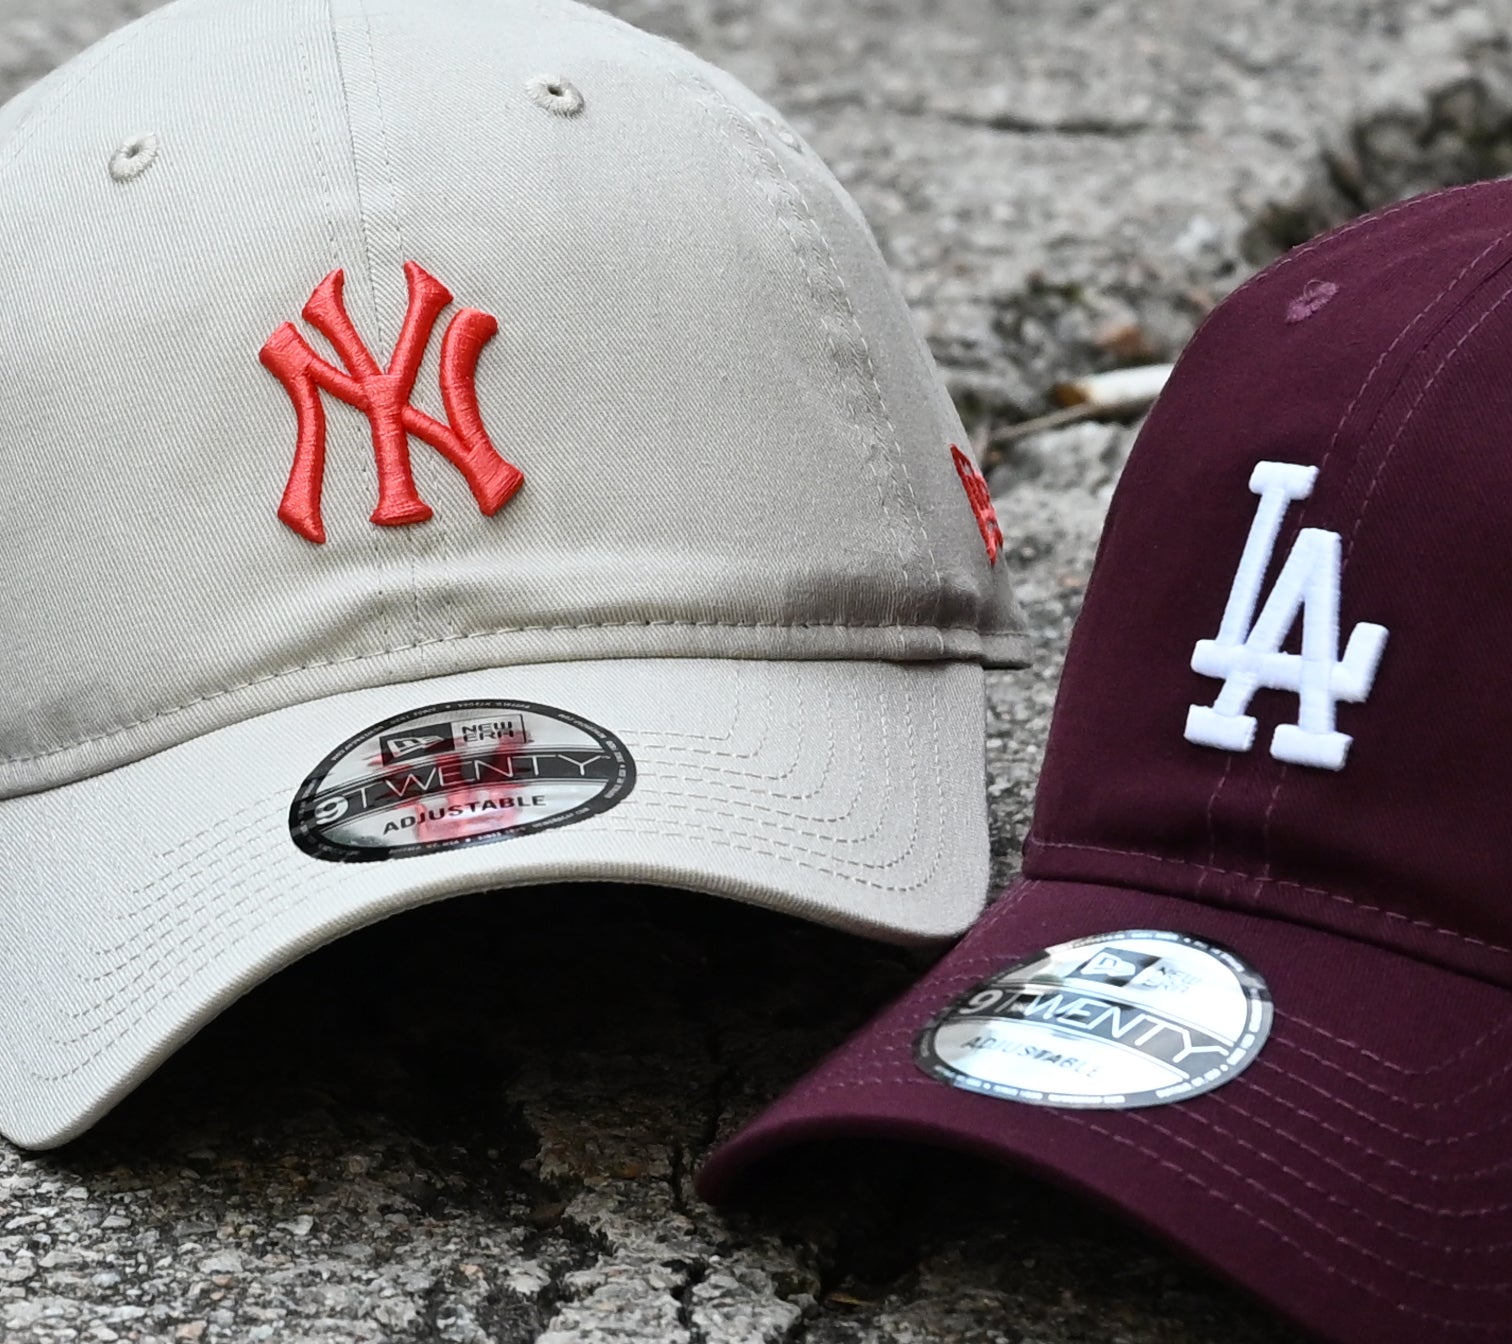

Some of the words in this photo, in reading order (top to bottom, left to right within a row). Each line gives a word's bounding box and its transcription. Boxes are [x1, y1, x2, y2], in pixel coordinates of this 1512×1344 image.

[258, 259, 525, 544] NY
[1184, 460, 1390, 771] LA
[461, 720, 513, 734] NEW
[463, 729, 515, 743] ERA
[314, 754, 605, 825] 9TWENTY
[383, 795, 547, 834] ADJUSTABLE
[959, 989, 1230, 1064] 9TWENTY
